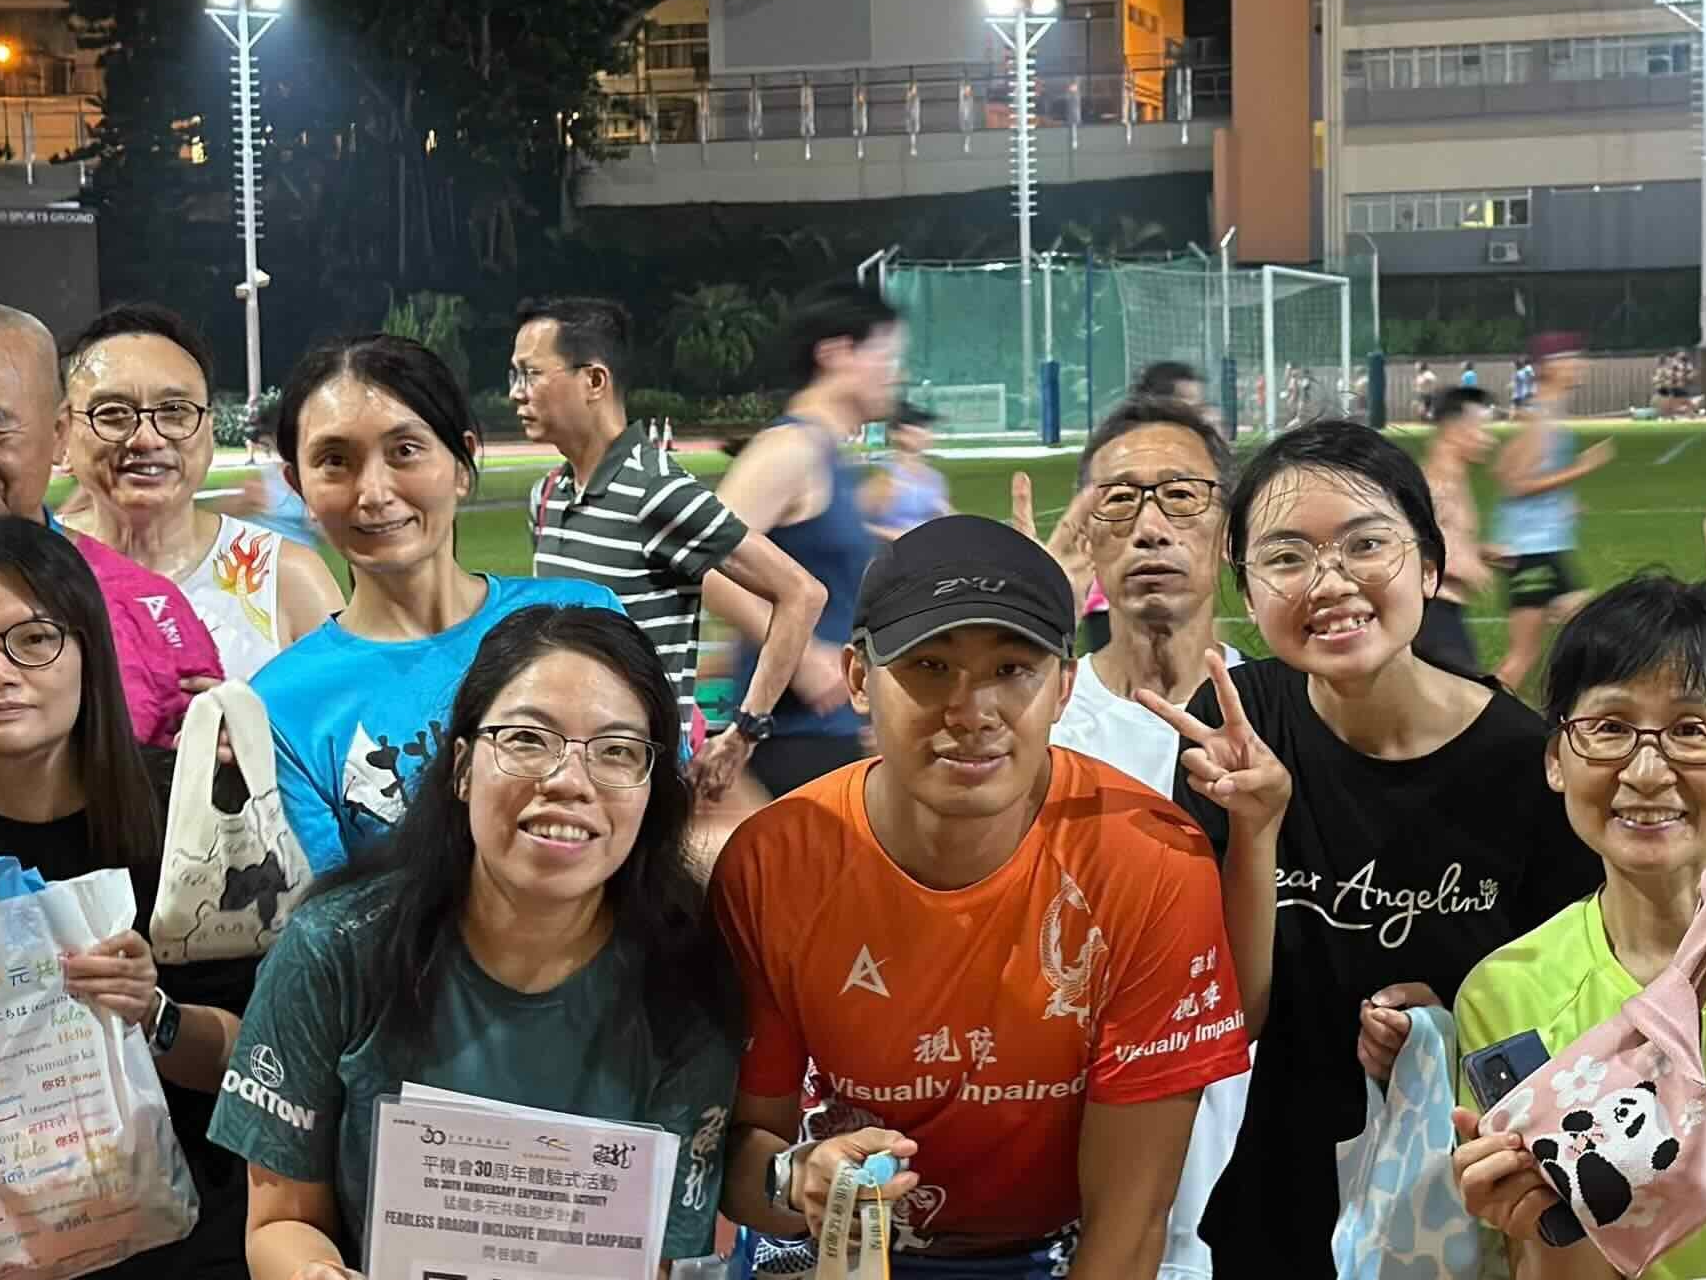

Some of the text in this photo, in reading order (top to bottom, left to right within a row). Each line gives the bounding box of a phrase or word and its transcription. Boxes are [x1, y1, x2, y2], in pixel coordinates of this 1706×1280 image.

[1276, 868, 1323, 892] ear
[1194, 1009, 1245, 1042] Impair
[221, 1069, 316, 1131] OCKTON
[829, 1071, 951, 1103] Visually
[385, 1210, 434, 1230] FEARLESS
[481, 1221, 535, 1241] INCLUSIVE
